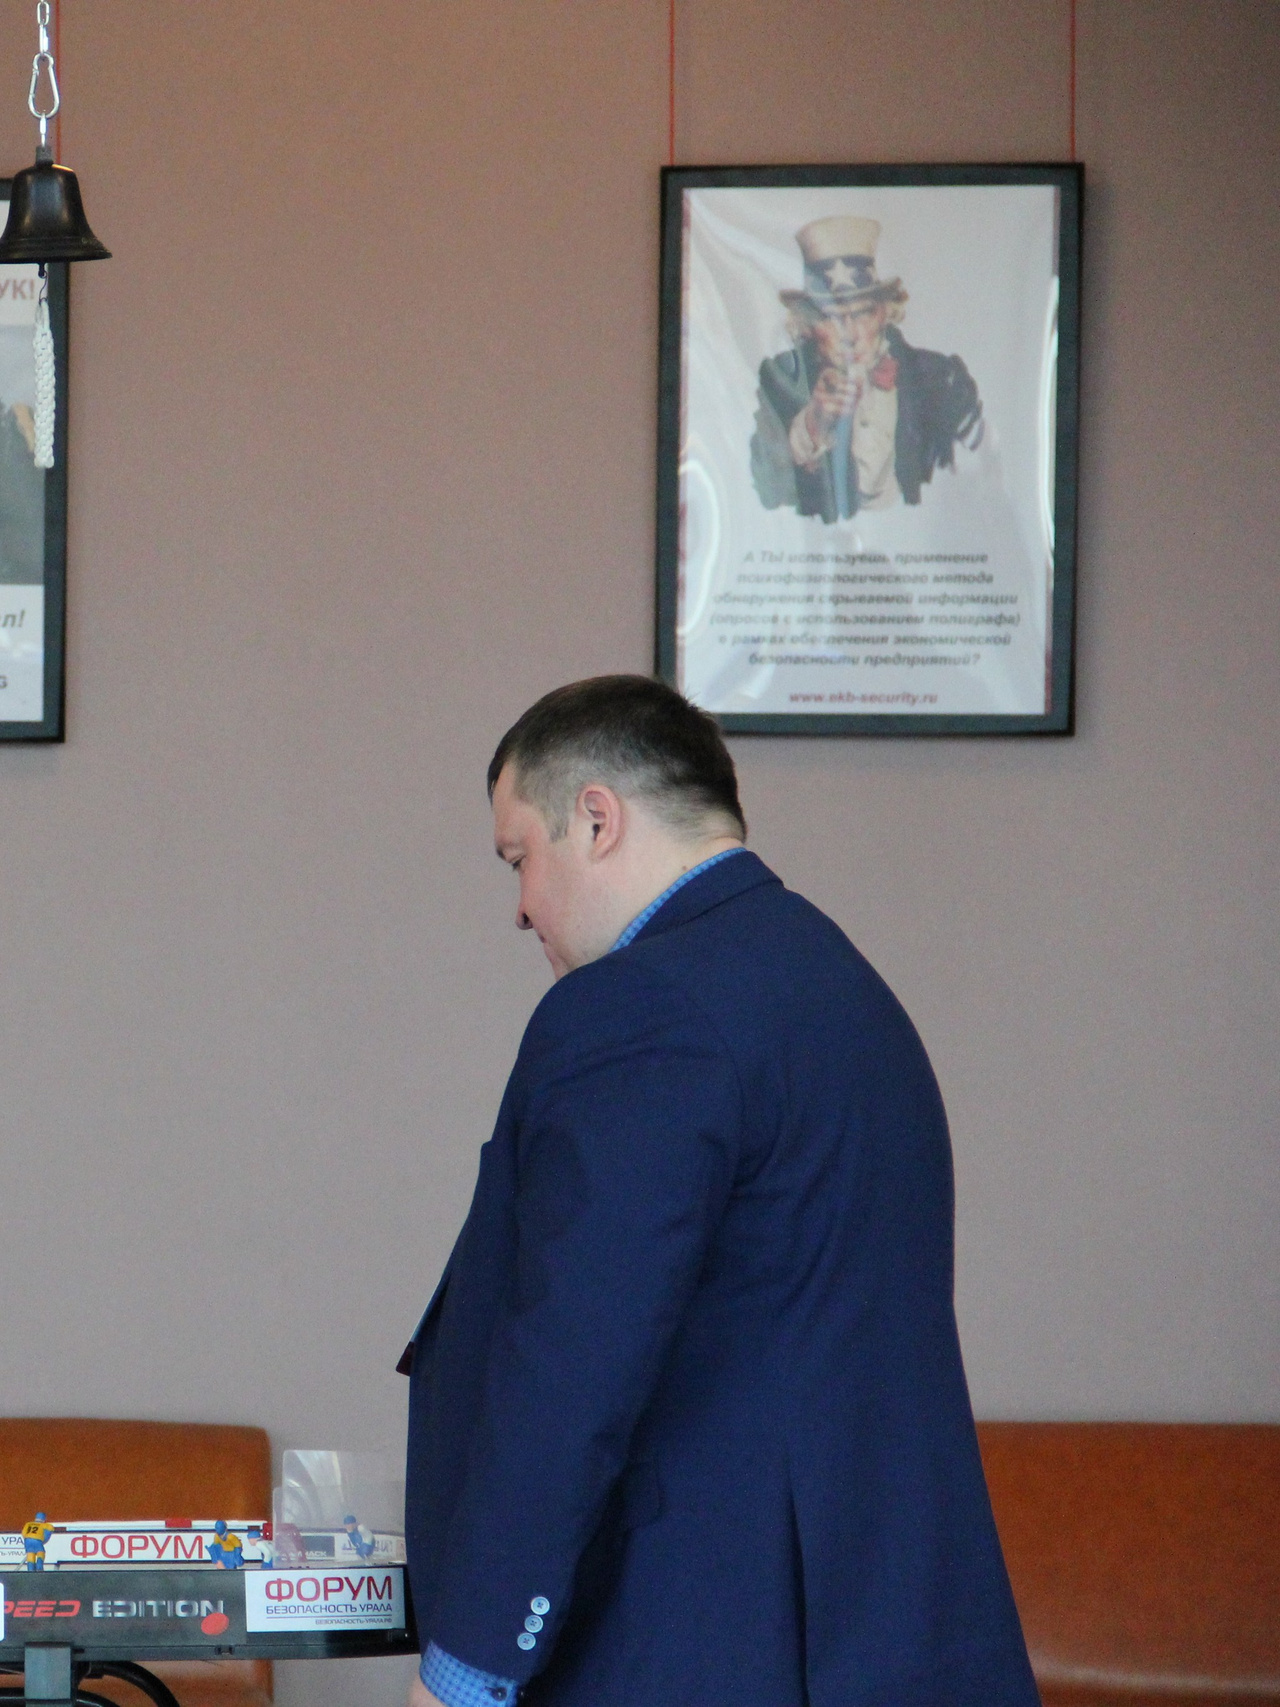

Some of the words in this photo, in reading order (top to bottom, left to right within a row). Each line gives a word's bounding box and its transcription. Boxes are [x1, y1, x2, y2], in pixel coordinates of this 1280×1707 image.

[70, 1535, 203, 1559] ФОРУМ
[265, 1576, 393, 1602] ФОРУМ
[4, 1600, 81, 1617] PEED
[93, 1600, 224, 1617] EDITION
[266, 1604, 357, 1614] БЕЗОПАСНОСТЬ
[359, 1603, 392, 1612] УРАЛА
